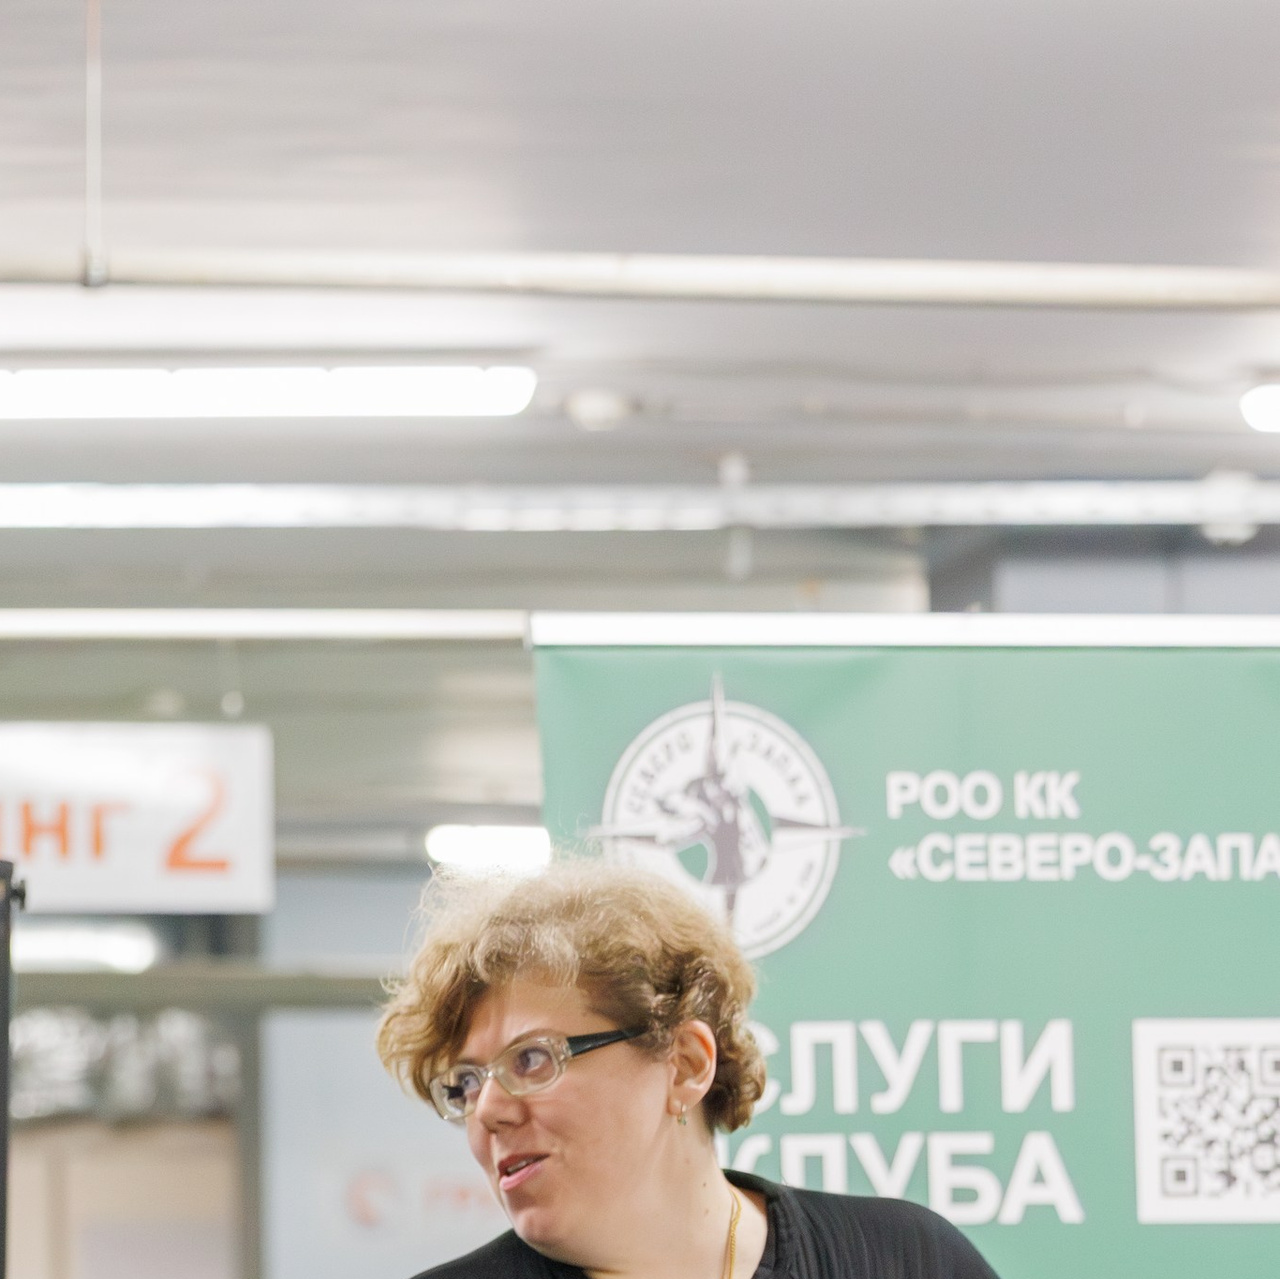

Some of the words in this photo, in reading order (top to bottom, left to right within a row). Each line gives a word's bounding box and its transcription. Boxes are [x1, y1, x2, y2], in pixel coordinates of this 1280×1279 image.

[164, 770, 233, 874] 2
[886, 771, 1002, 819] РОО
[1015, 771, 1081, 819] КК
